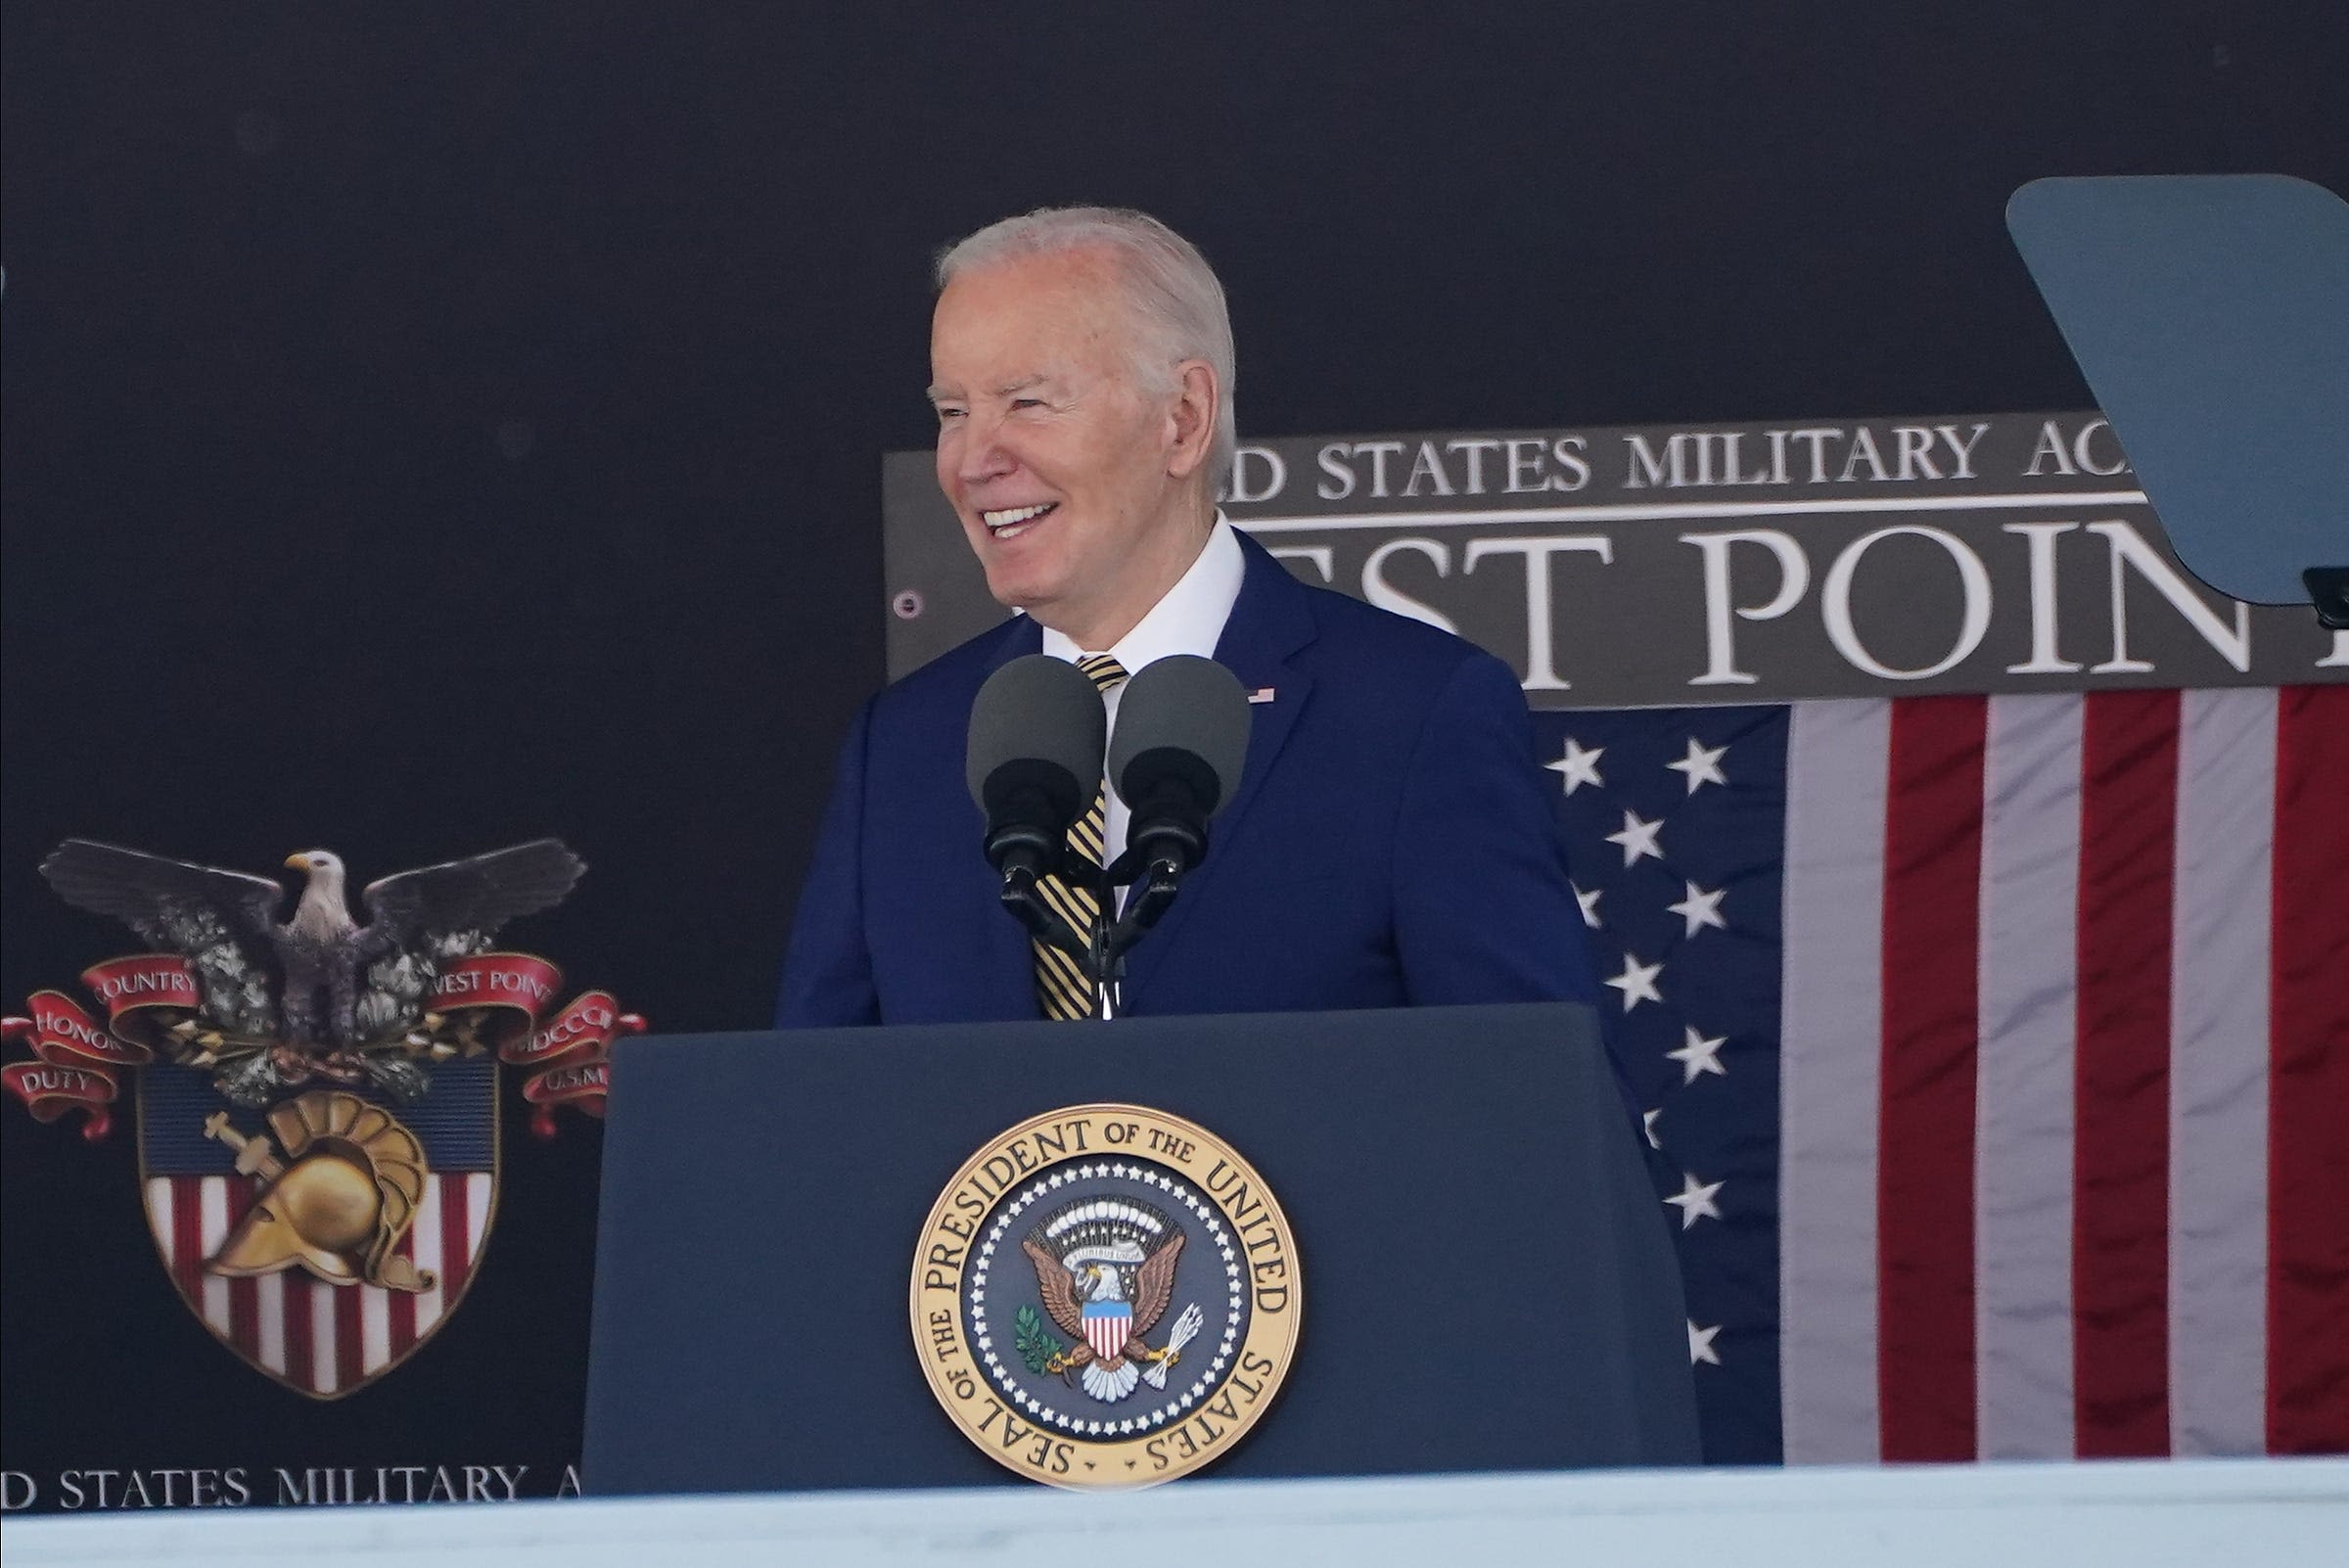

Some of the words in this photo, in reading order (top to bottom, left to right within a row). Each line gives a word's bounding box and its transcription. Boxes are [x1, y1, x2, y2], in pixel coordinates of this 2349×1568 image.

[1217, 447, 1287, 502] D
[1317, 436, 1592, 500] STATES
[1622, 423, 1990, 488] MILITARY
[2021, 419, 2135, 476] AC
[1679, 518, 2349, 687] POIN
[22, 1070, 88, 1093] DUTY
[1104, 1123, 1140, 1144] OF
[1148, 1128, 1196, 1164] THE
[925, 1120, 1091, 1293] PRESIDENT
[1206, 1159, 1288, 1314] UNITED
[930, 1309, 959, 1362] THE
[945, 1369, 976, 1400] OF
[1146, 1352, 1273, 1470] STATES
[978, 1398, 1075, 1474] SEAL
[60, 1468, 251, 1509] STATES
[276, 1464, 530, 1506] MILITARY
